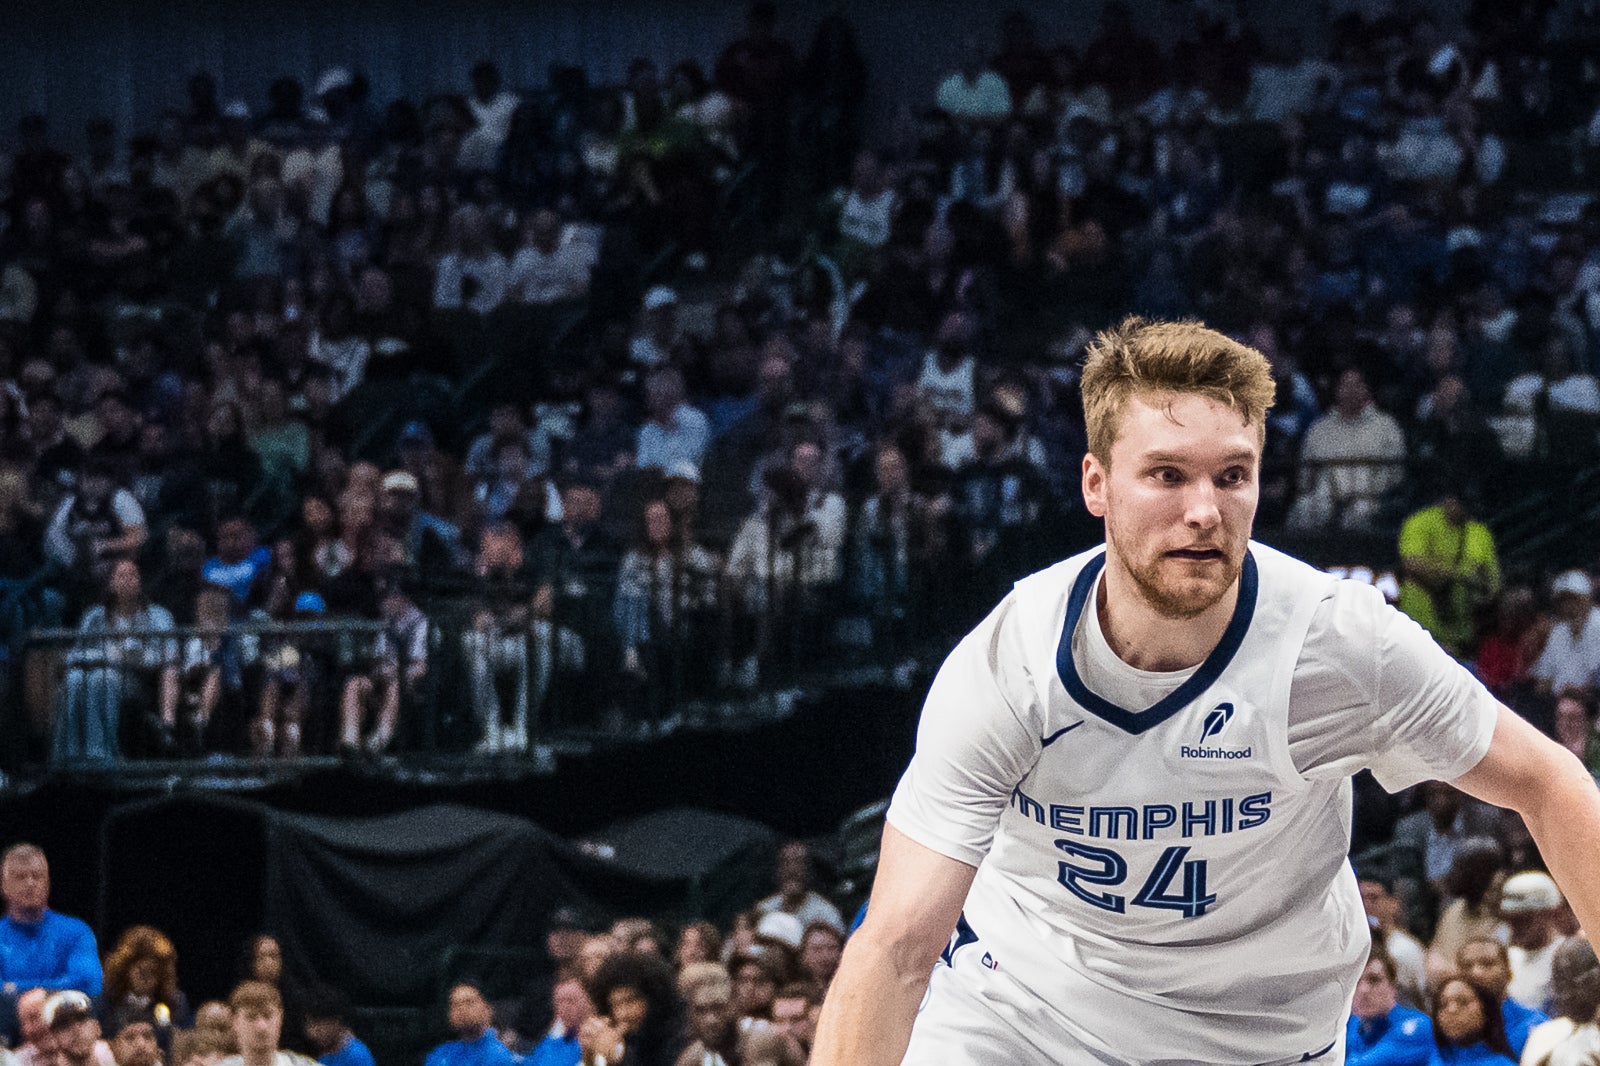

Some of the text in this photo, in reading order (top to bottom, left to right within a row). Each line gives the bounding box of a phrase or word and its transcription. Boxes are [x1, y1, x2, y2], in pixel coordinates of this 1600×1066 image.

[1181, 745, 1252, 760] Robinhood
[1011, 787, 1272, 840] MEMPHIS
[1053, 838, 1218, 919] 24
